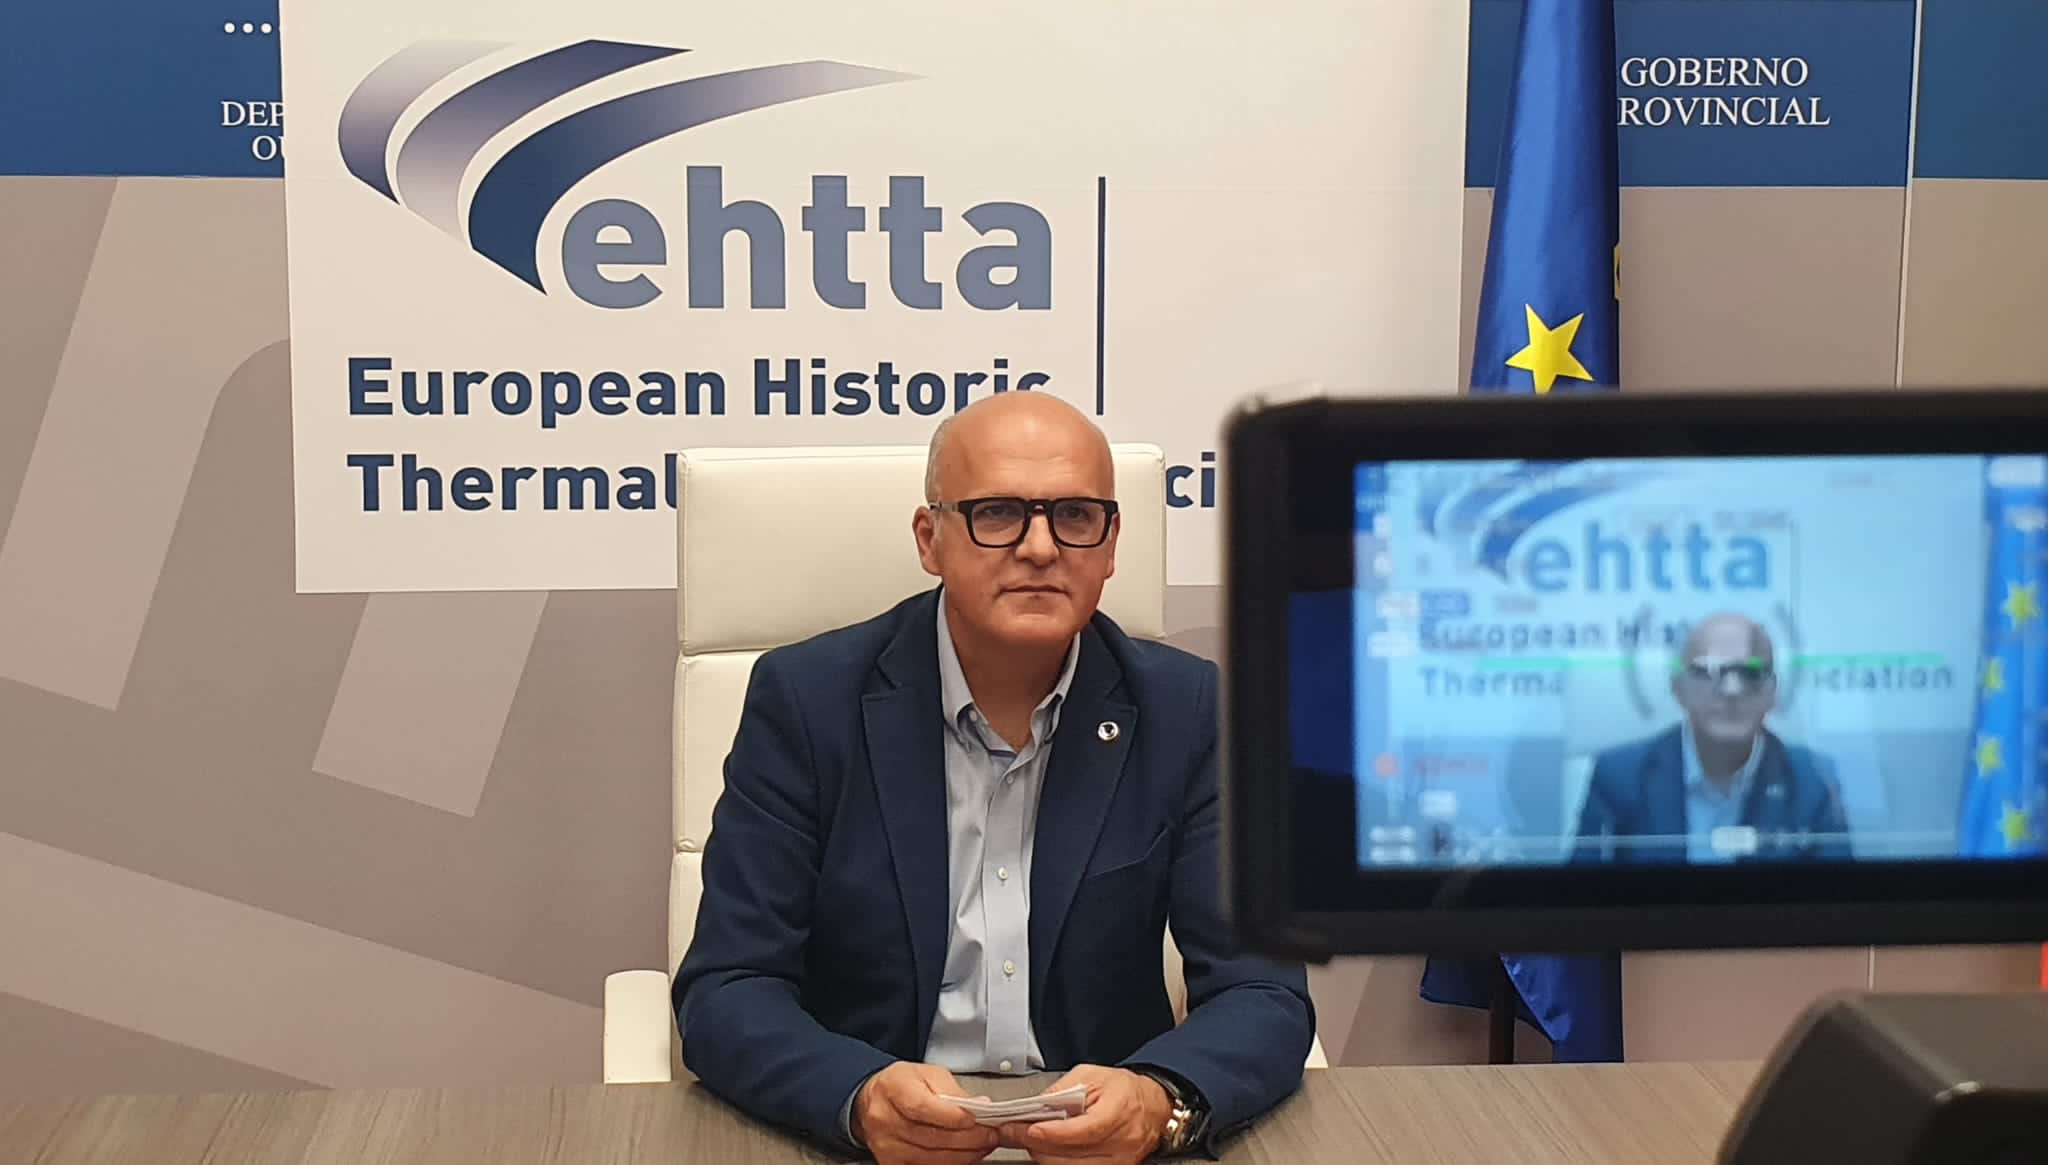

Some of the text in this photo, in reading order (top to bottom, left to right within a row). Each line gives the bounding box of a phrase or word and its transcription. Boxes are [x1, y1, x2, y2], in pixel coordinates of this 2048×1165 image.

[1620, 56, 1809, 87] GOBERNO
[1617, 96, 1831, 127] ROVINCIAL
[560, 164, 1053, 311] ehtta
[347, 356, 727, 430] European
[345, 452, 678, 512] Thermal
[1524, 521, 1771, 592] ehtta
